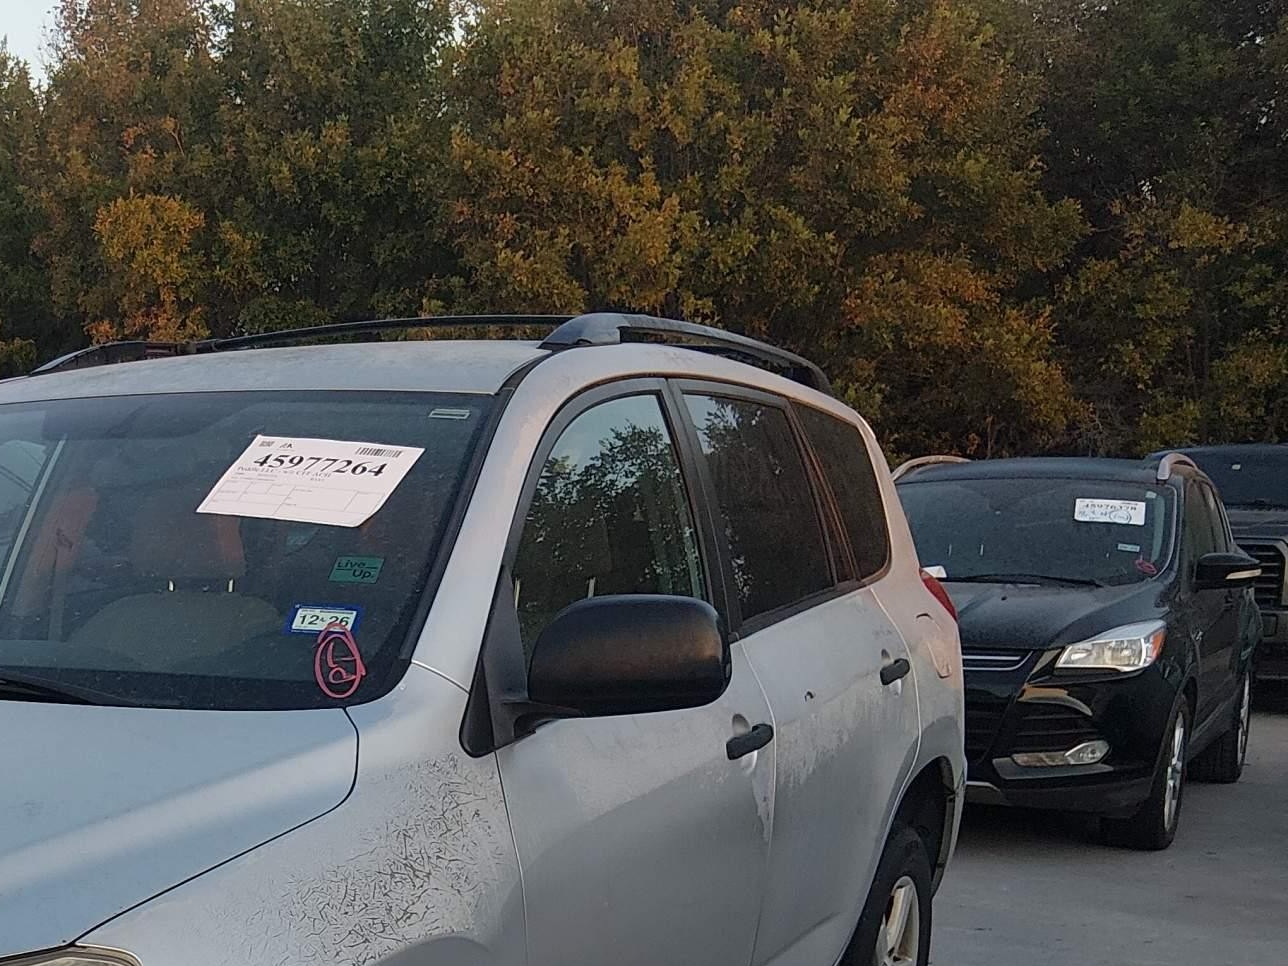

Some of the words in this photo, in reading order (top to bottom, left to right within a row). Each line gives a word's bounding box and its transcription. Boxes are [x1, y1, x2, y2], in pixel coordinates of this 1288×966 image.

[253, 453, 388, 477] 45977264
[337, 560, 366, 568] Live
[300, 614, 319, 625] 12
